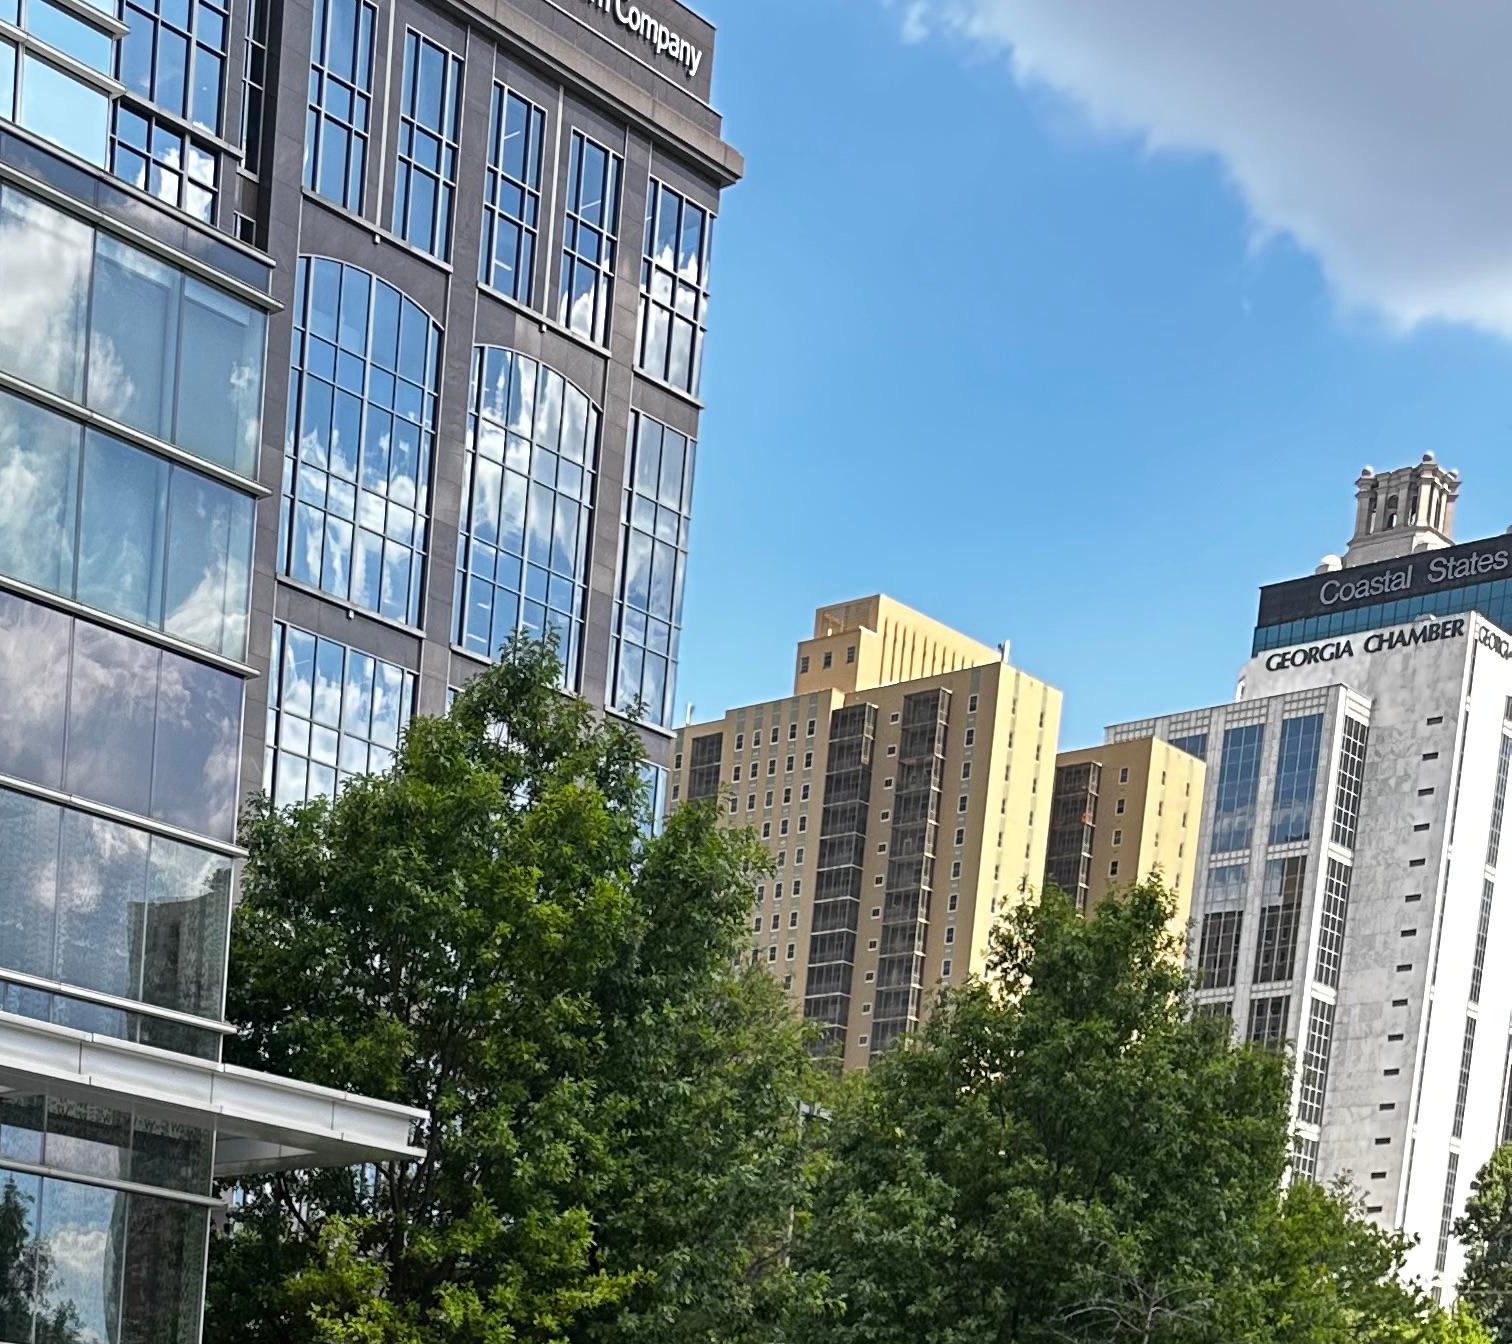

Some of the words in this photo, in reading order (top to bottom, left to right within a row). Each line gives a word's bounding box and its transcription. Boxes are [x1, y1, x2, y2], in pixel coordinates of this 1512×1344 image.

[615, 0, 703, 77] Company
[1319, 564, 1413, 605] Coastal
[1427, 549, 1509, 584] States
[1265, 639, 1354, 672] GEORGIA
[1363, 618, 1465, 654] CHAMBER
